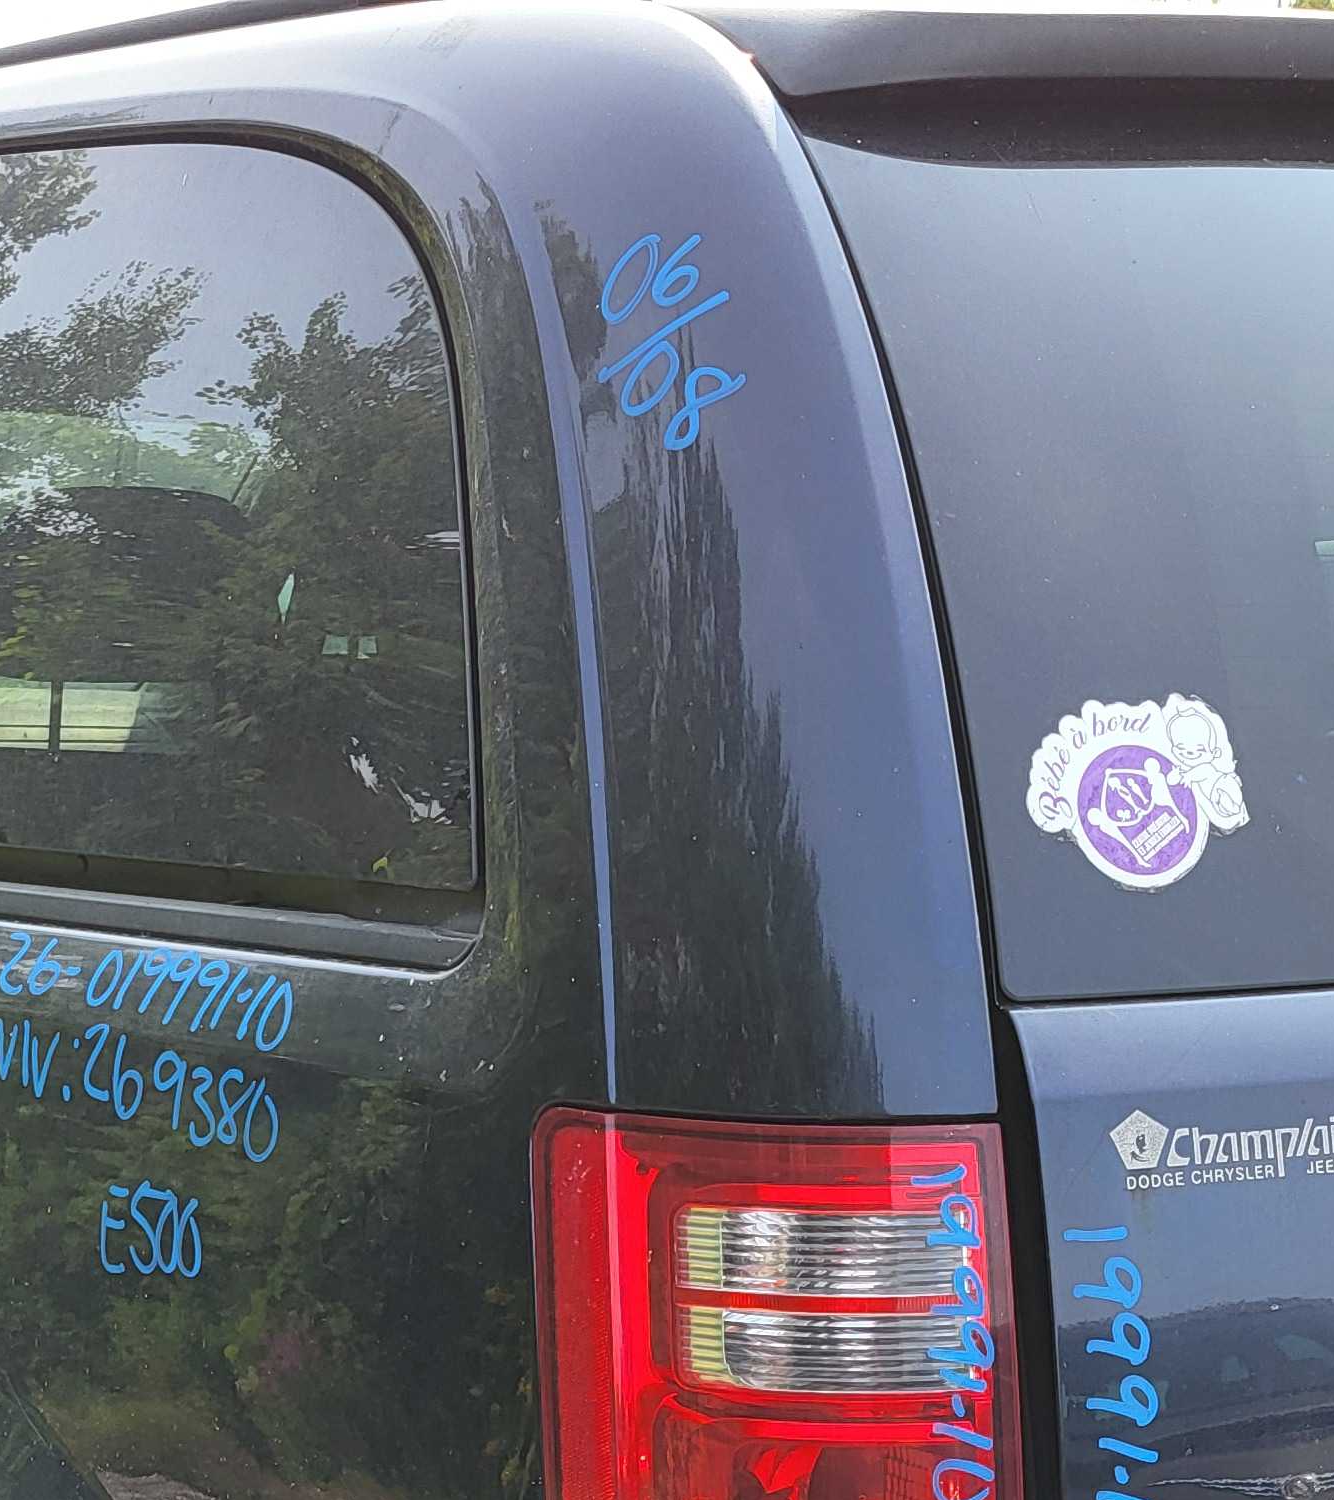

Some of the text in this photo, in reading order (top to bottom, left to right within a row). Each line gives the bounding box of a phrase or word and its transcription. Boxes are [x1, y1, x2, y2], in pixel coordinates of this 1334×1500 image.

[1091, 712, 1152, 738] bord
[1125, 1170, 1186, 1190] DODGE
[1190, 1164, 1276, 1185] CHRYSLER
